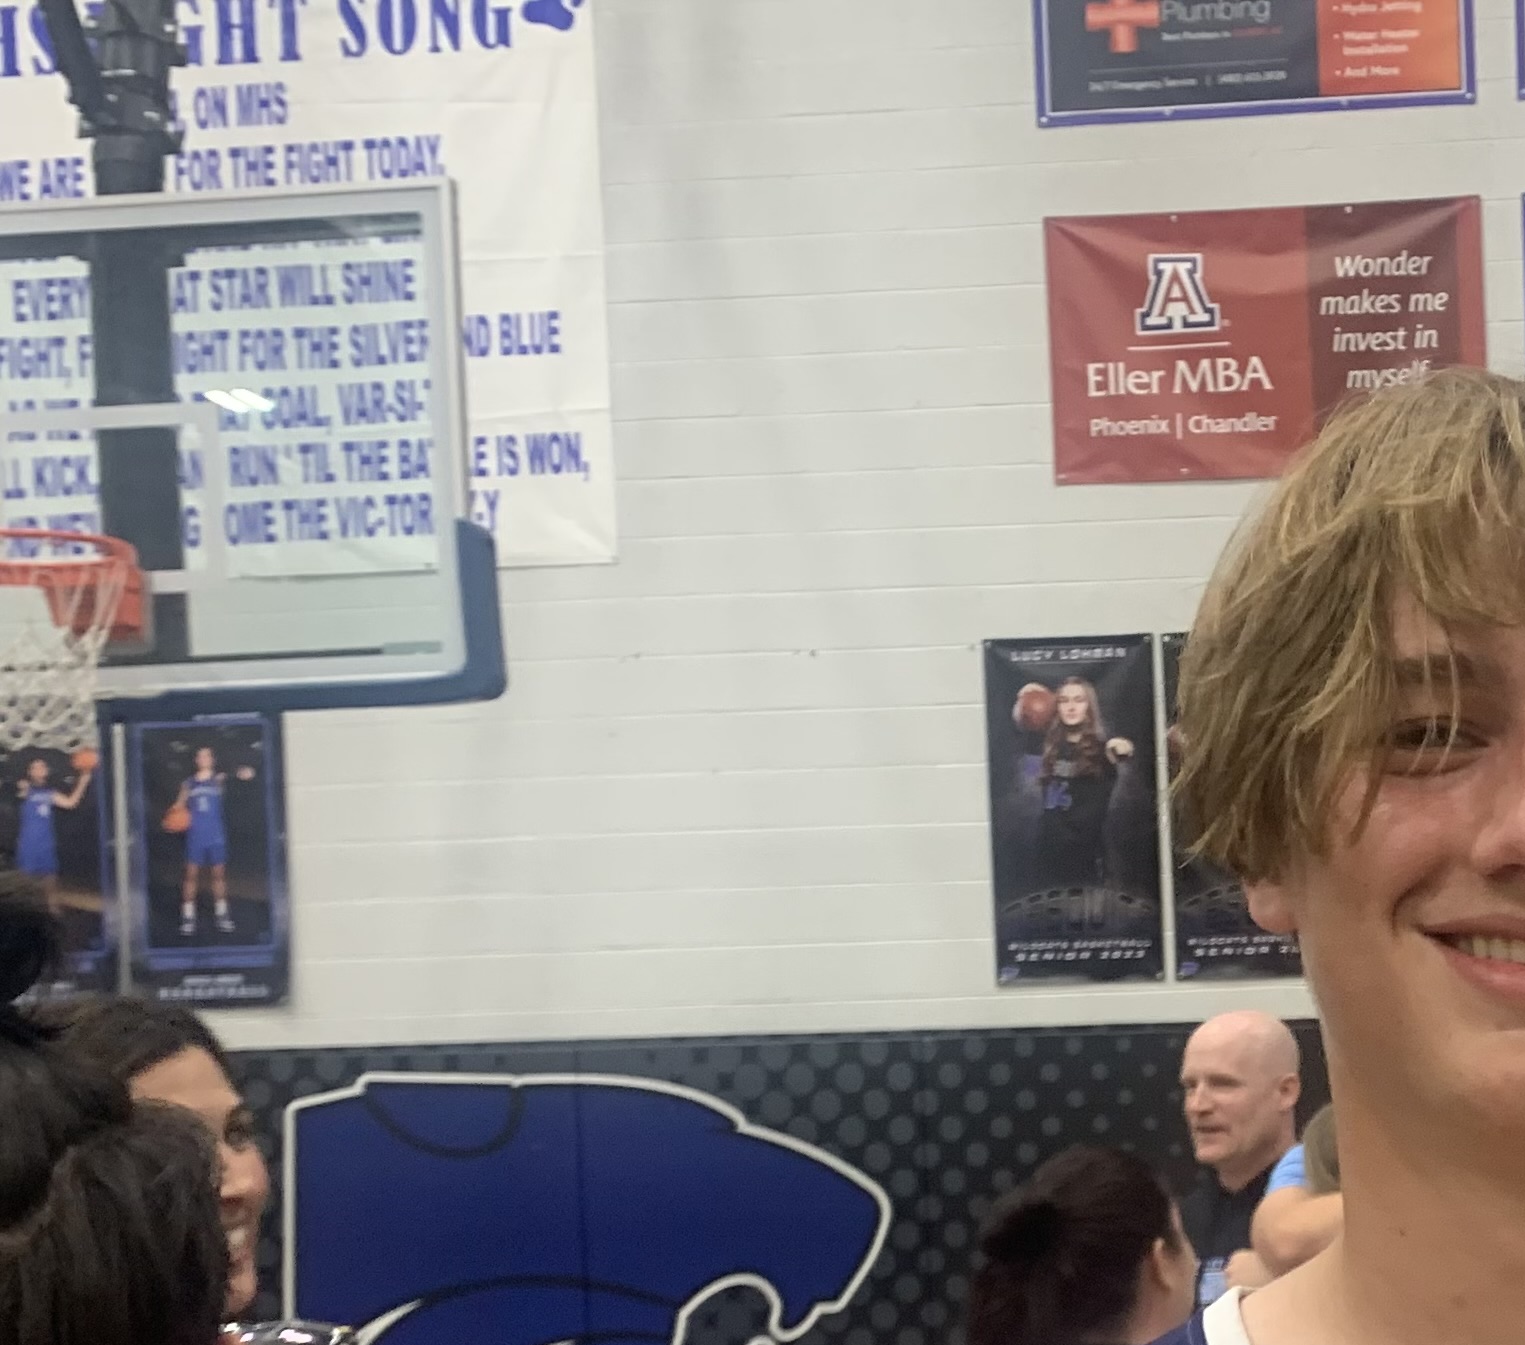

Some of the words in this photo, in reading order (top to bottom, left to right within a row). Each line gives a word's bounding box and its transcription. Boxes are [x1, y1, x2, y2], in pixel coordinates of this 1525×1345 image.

[338, 0, 513, 58] SONG
[194, 86, 229, 129] ON
[236, 82, 288, 127] MHS
[40, 157, 84, 199] ARE
[175, 149, 222, 192] FOR
[229, 146, 277, 187] THE
[285, 142, 355, 185] FIGHT
[210, 266, 271, 311] STAR
[276, 263, 334, 306] WILL
[341, 260, 416, 305] SHINE
[1335, 250, 1433, 278] Wonder
[1320, 288, 1402, 315] makes
[1408, 291, 1449, 312] me
[172, 330, 229, 374] IGHT
[238, 329, 286, 371] FOR
[293, 327, 340, 369] THE
[499, 310, 560, 356] BLUE
[1332, 326, 1408, 352] invest
[1413, 324, 1439, 348] in
[1087, 361, 1167, 397] Eller
[1173, 355, 1275, 393] MBA
[1089, 414, 1171, 437] Phoenix
[1188, 411, 1278, 434] Chandler
[229, 446, 279, 487] RUN
[340, 440, 389, 482] THE
[496, 435, 520, 476] IS
[224, 500, 277, 546] OME
[282, 498, 331, 541] THE
